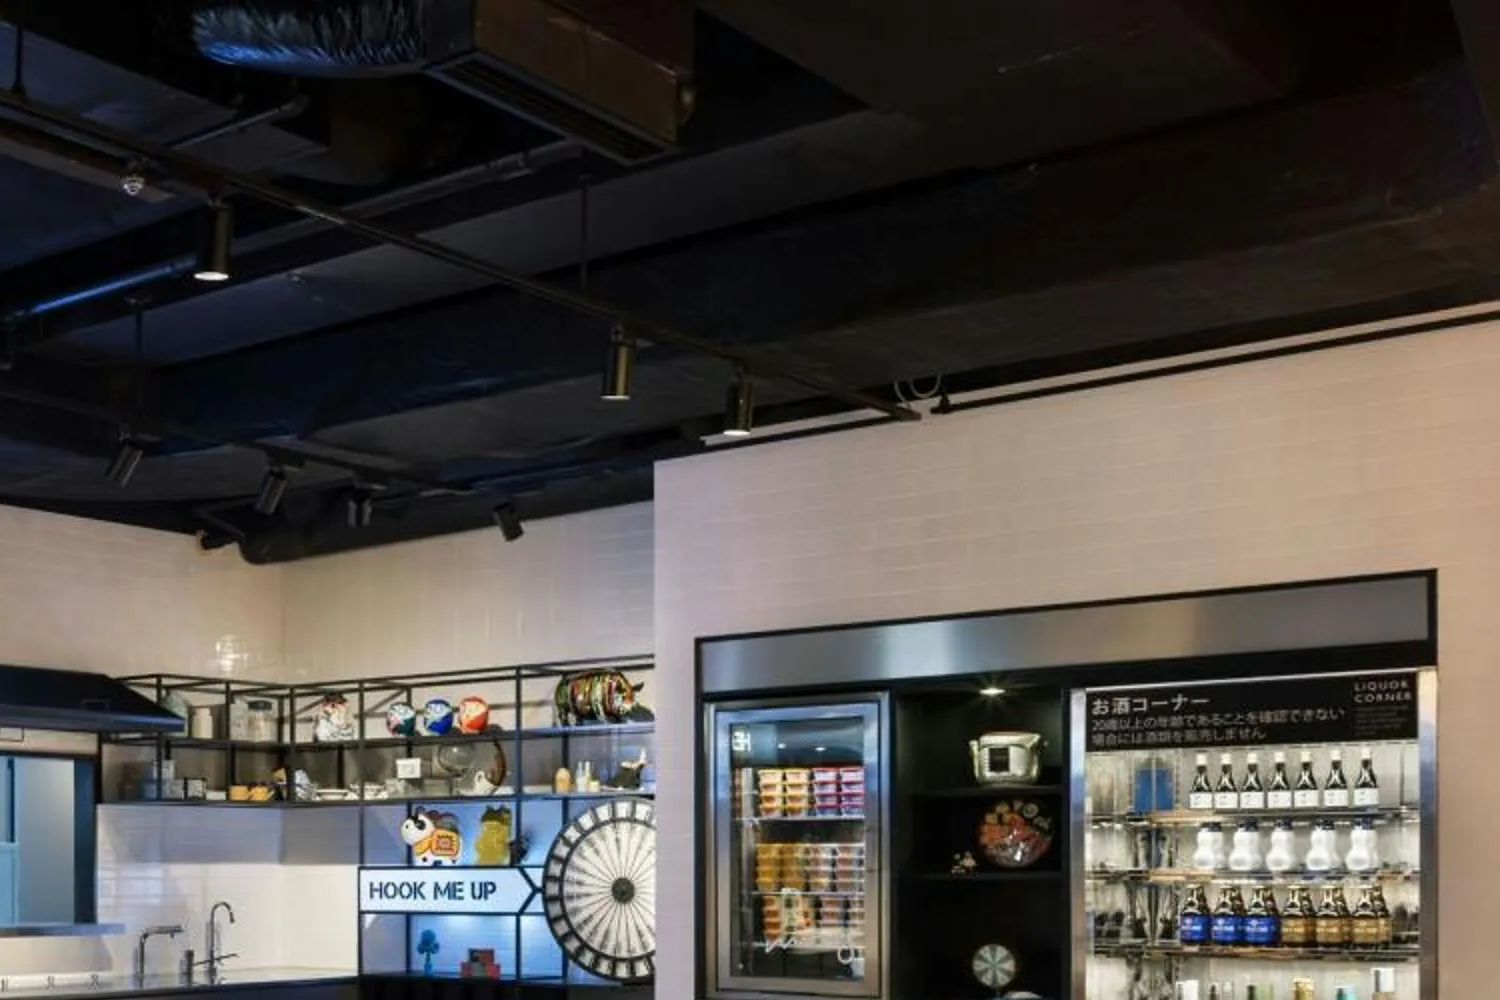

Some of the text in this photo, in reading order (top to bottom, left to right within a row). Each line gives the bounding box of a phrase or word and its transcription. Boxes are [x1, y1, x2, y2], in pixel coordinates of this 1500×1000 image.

[1091, 693, 1210, 716] お酒コーナー
[1353, 691, 1413, 704] CORNER
[368, 881, 497, 901] HOOK ME UP
